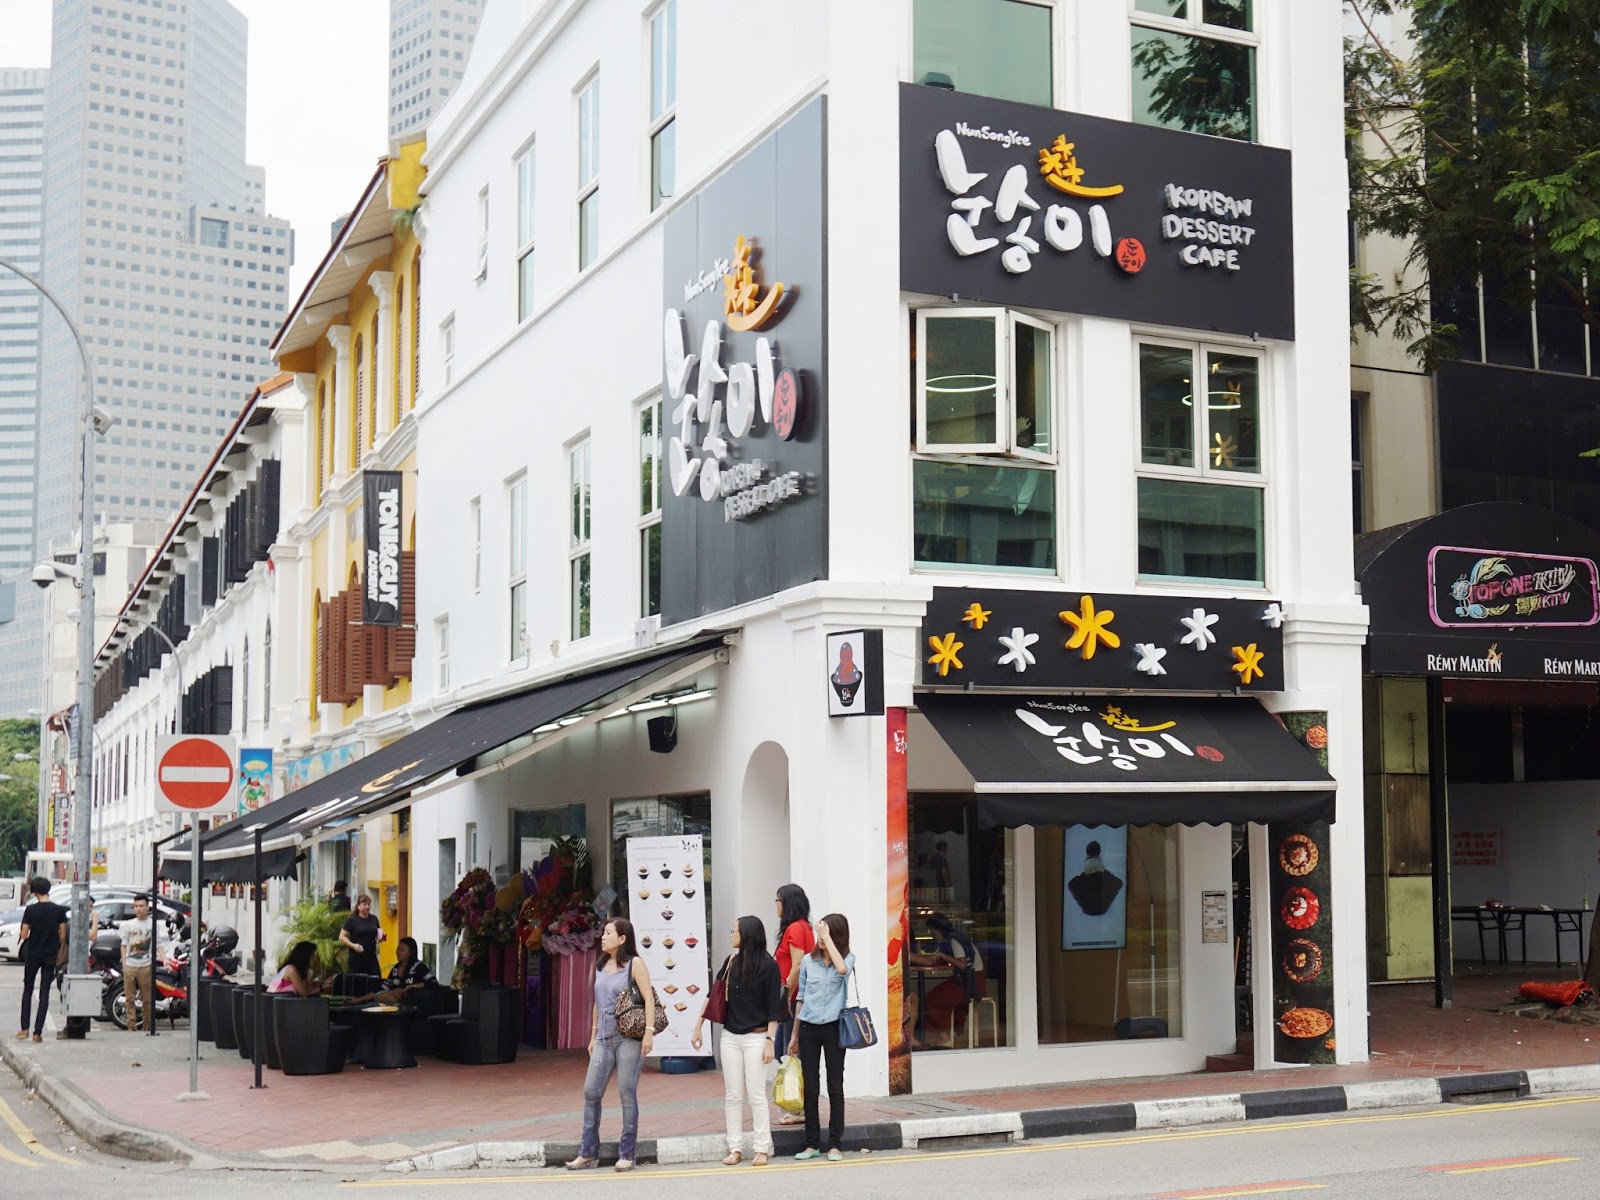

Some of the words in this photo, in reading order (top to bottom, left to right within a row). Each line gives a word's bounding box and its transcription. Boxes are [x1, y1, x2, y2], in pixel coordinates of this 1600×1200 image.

[955, 121, 1031, 149] NunSongYee
[935, 129, 1113, 274] 눈송이
[1163, 183, 1253, 219] KOREAN
[1162, 214, 1255, 247] DESSERT
[1178, 244, 1241, 272] CAFE
[684, 257, 730, 303] NunSongYee
[664, 308, 775, 501] 눈송이
[378, 488, 398, 610] TONI&GUY
[367, 549, 378, 602] ACADEMY
[1469, 580, 1500, 604] TOP
[1501, 574, 1536, 597] ONE
[1027, 700, 1091, 714] NunSongYee
[1015, 708, 1194, 771] 눈송이
